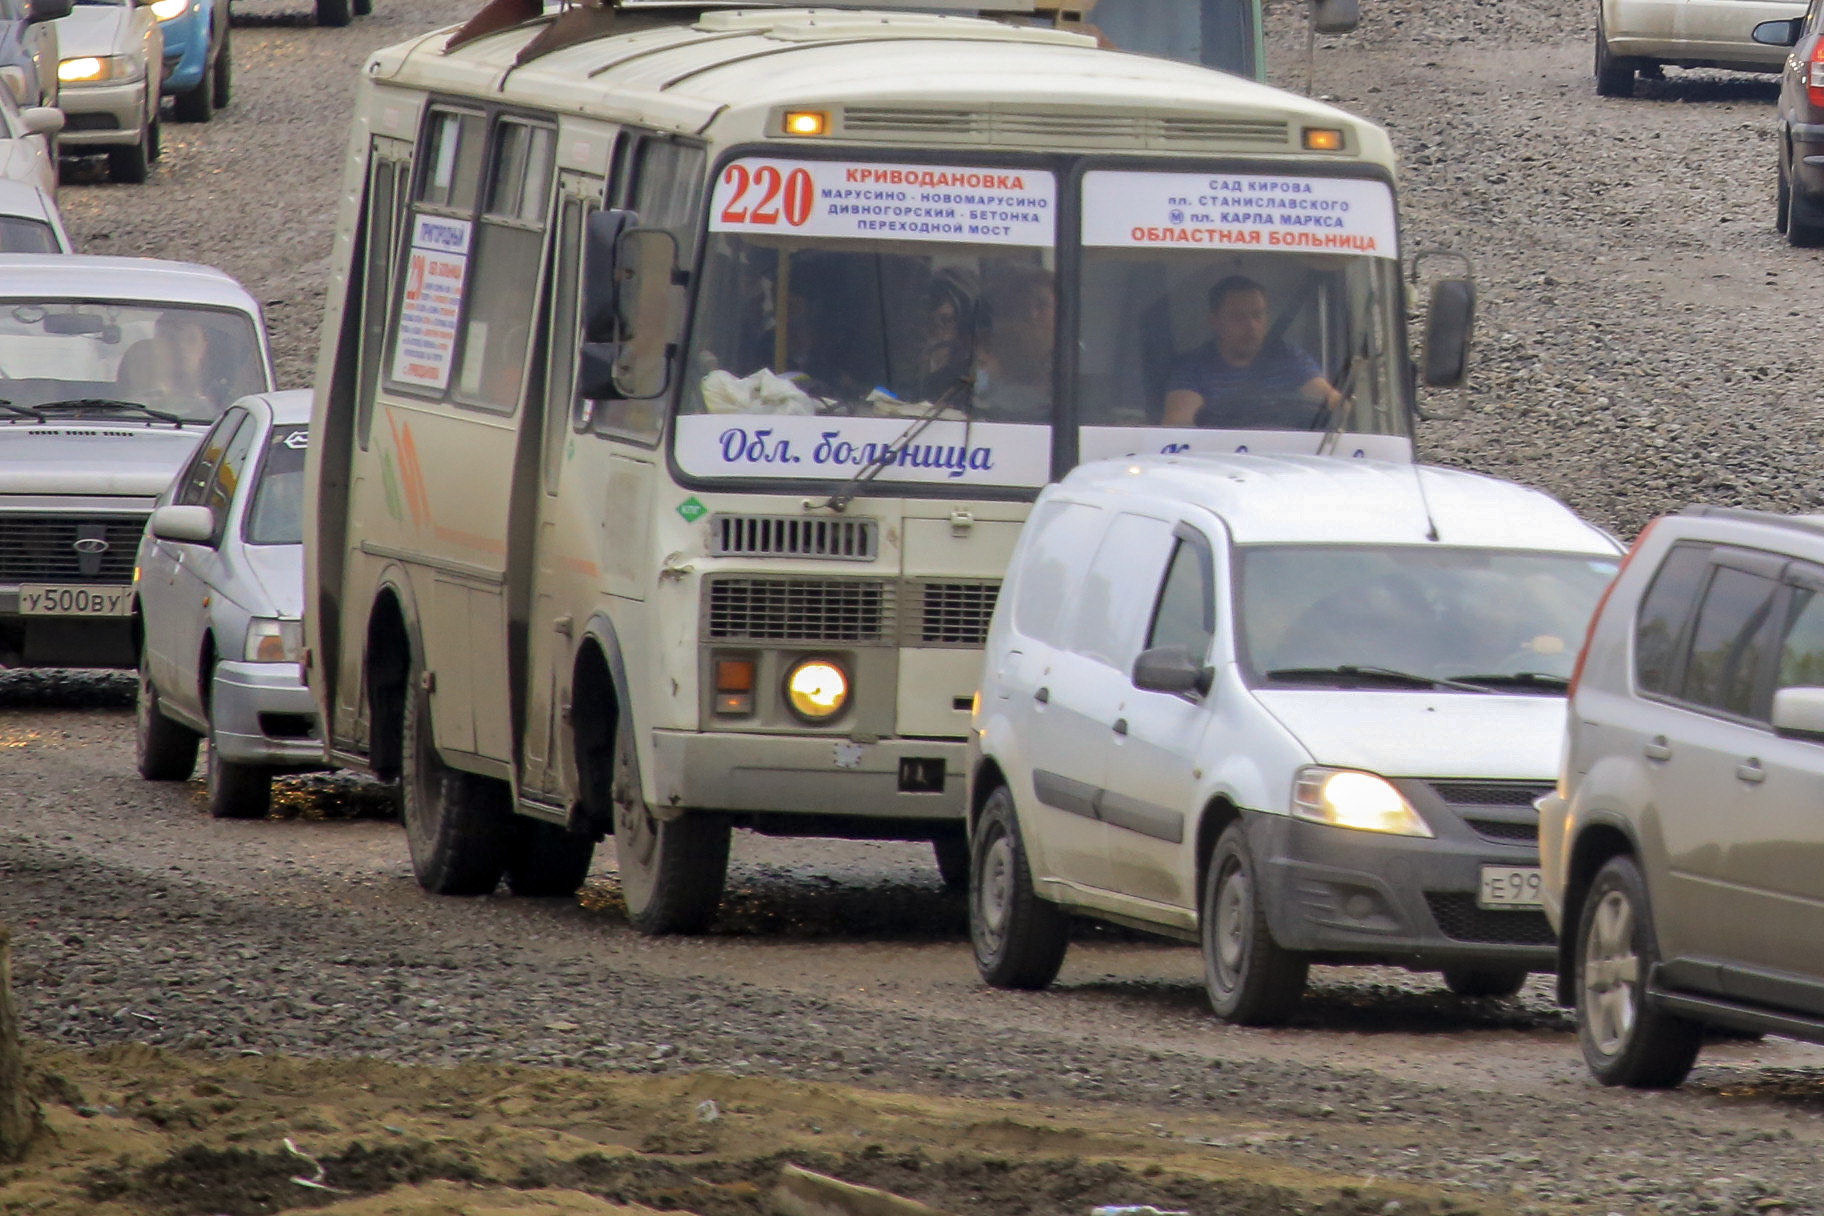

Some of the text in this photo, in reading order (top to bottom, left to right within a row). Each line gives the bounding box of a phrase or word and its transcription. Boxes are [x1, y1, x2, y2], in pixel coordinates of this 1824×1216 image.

[846, 168, 1025, 190] КРИВОДАНОВКА
[1208, 180, 1312, 194] САД КИРОВА
[721, 164, 814, 227] 220
[821, 189, 1048, 208] МАРУСИНО НОВОМАРУСИНО
[1198, 196, 1350, 212] СТАНИСЛАВСКОГО
[828, 203, 1040, 224] ДИВНОГОРСКИЙ БЕТОНКА
[1220, 212, 1274, 225] КАРЛА
[1279, 214, 1344, 228] МАРКСА
[857, 219, 1011, 236] ПЕРЕХОДНОЙ МОСТ
[1131, 226, 1377, 251] ОБЛАСТНАЯ БОЛЬНИЦА
[719, 427, 994, 478] Обл. больница
[29, 589, 120, 612] У500ВУ
